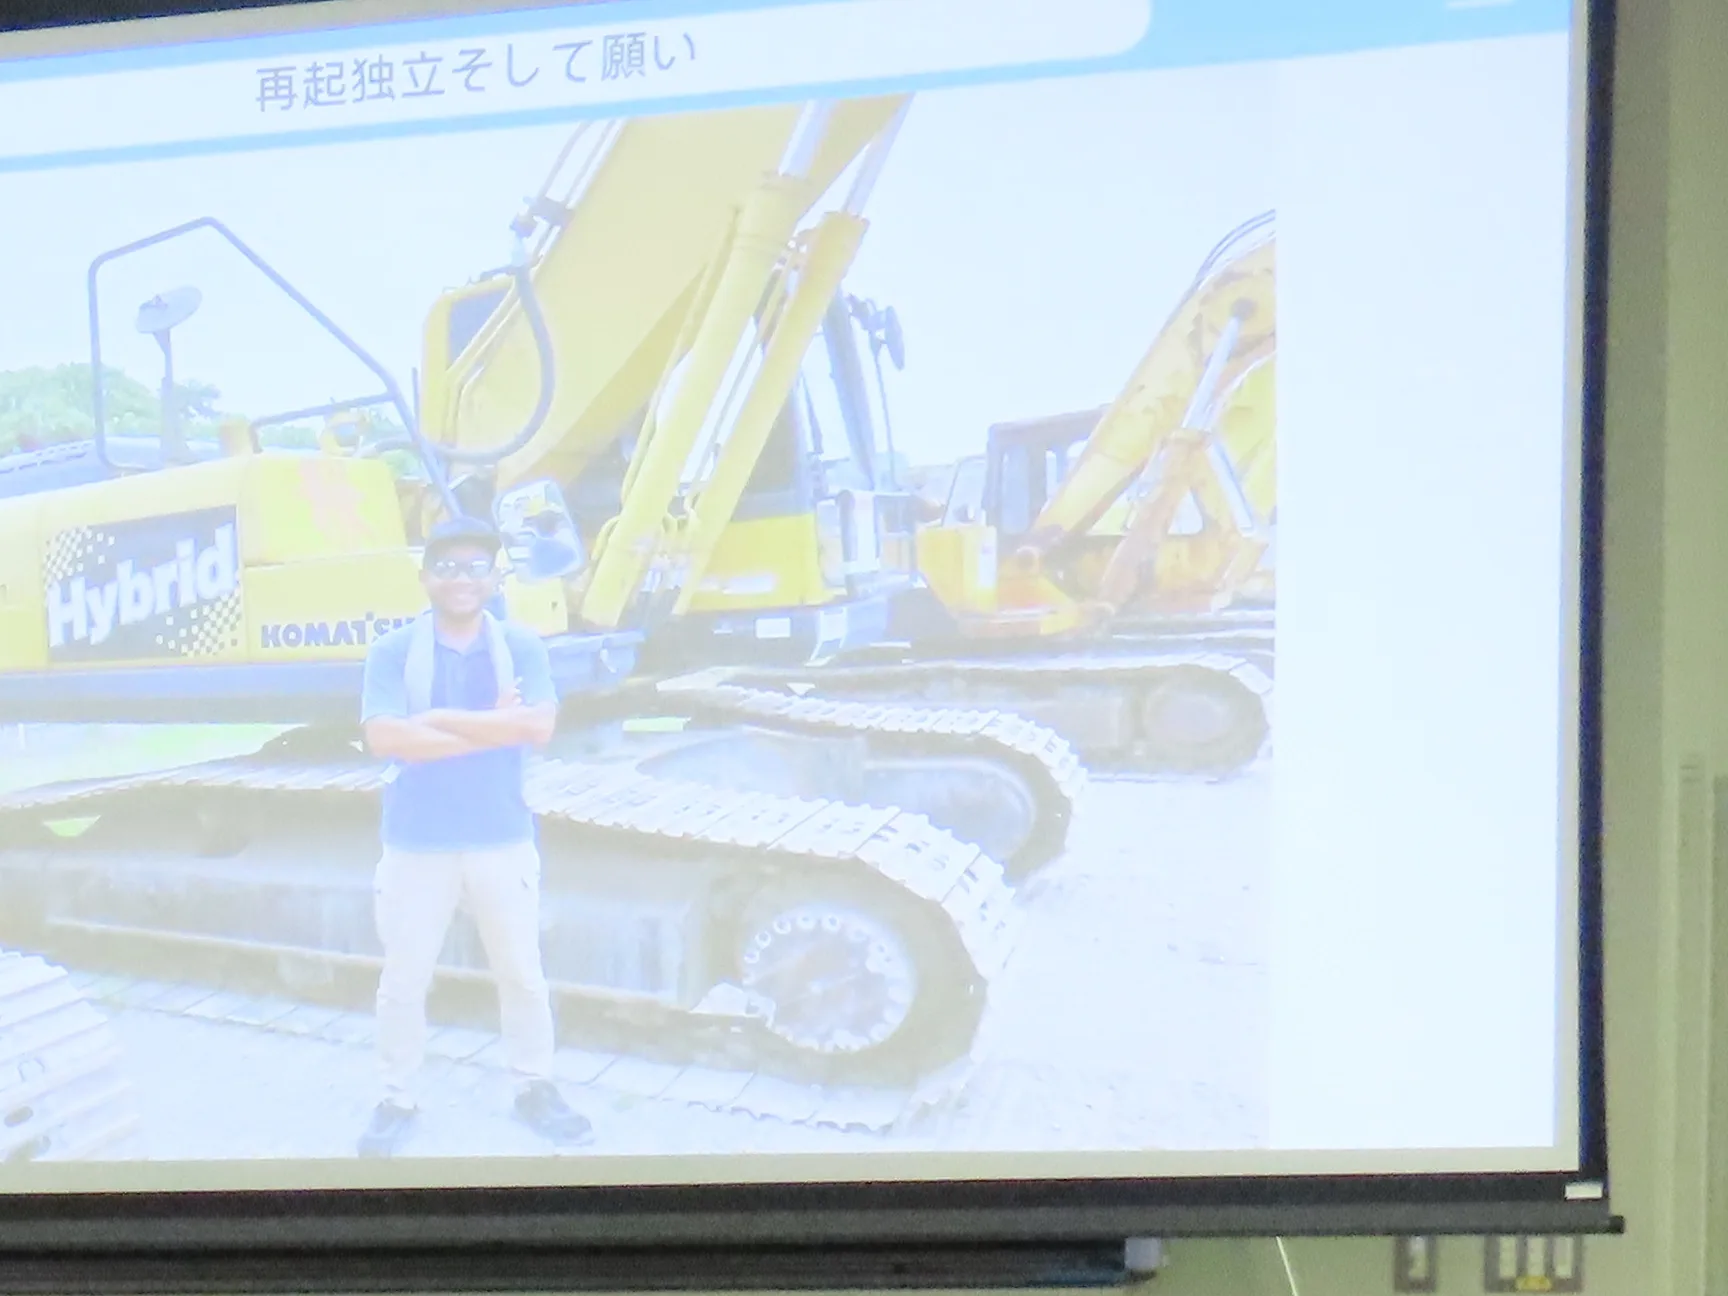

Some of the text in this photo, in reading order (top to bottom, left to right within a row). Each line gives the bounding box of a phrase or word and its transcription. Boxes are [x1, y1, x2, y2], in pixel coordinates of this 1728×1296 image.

[255, 30, 697, 113] 再起独立そして願い
[47, 522, 236, 648] Hybrid
